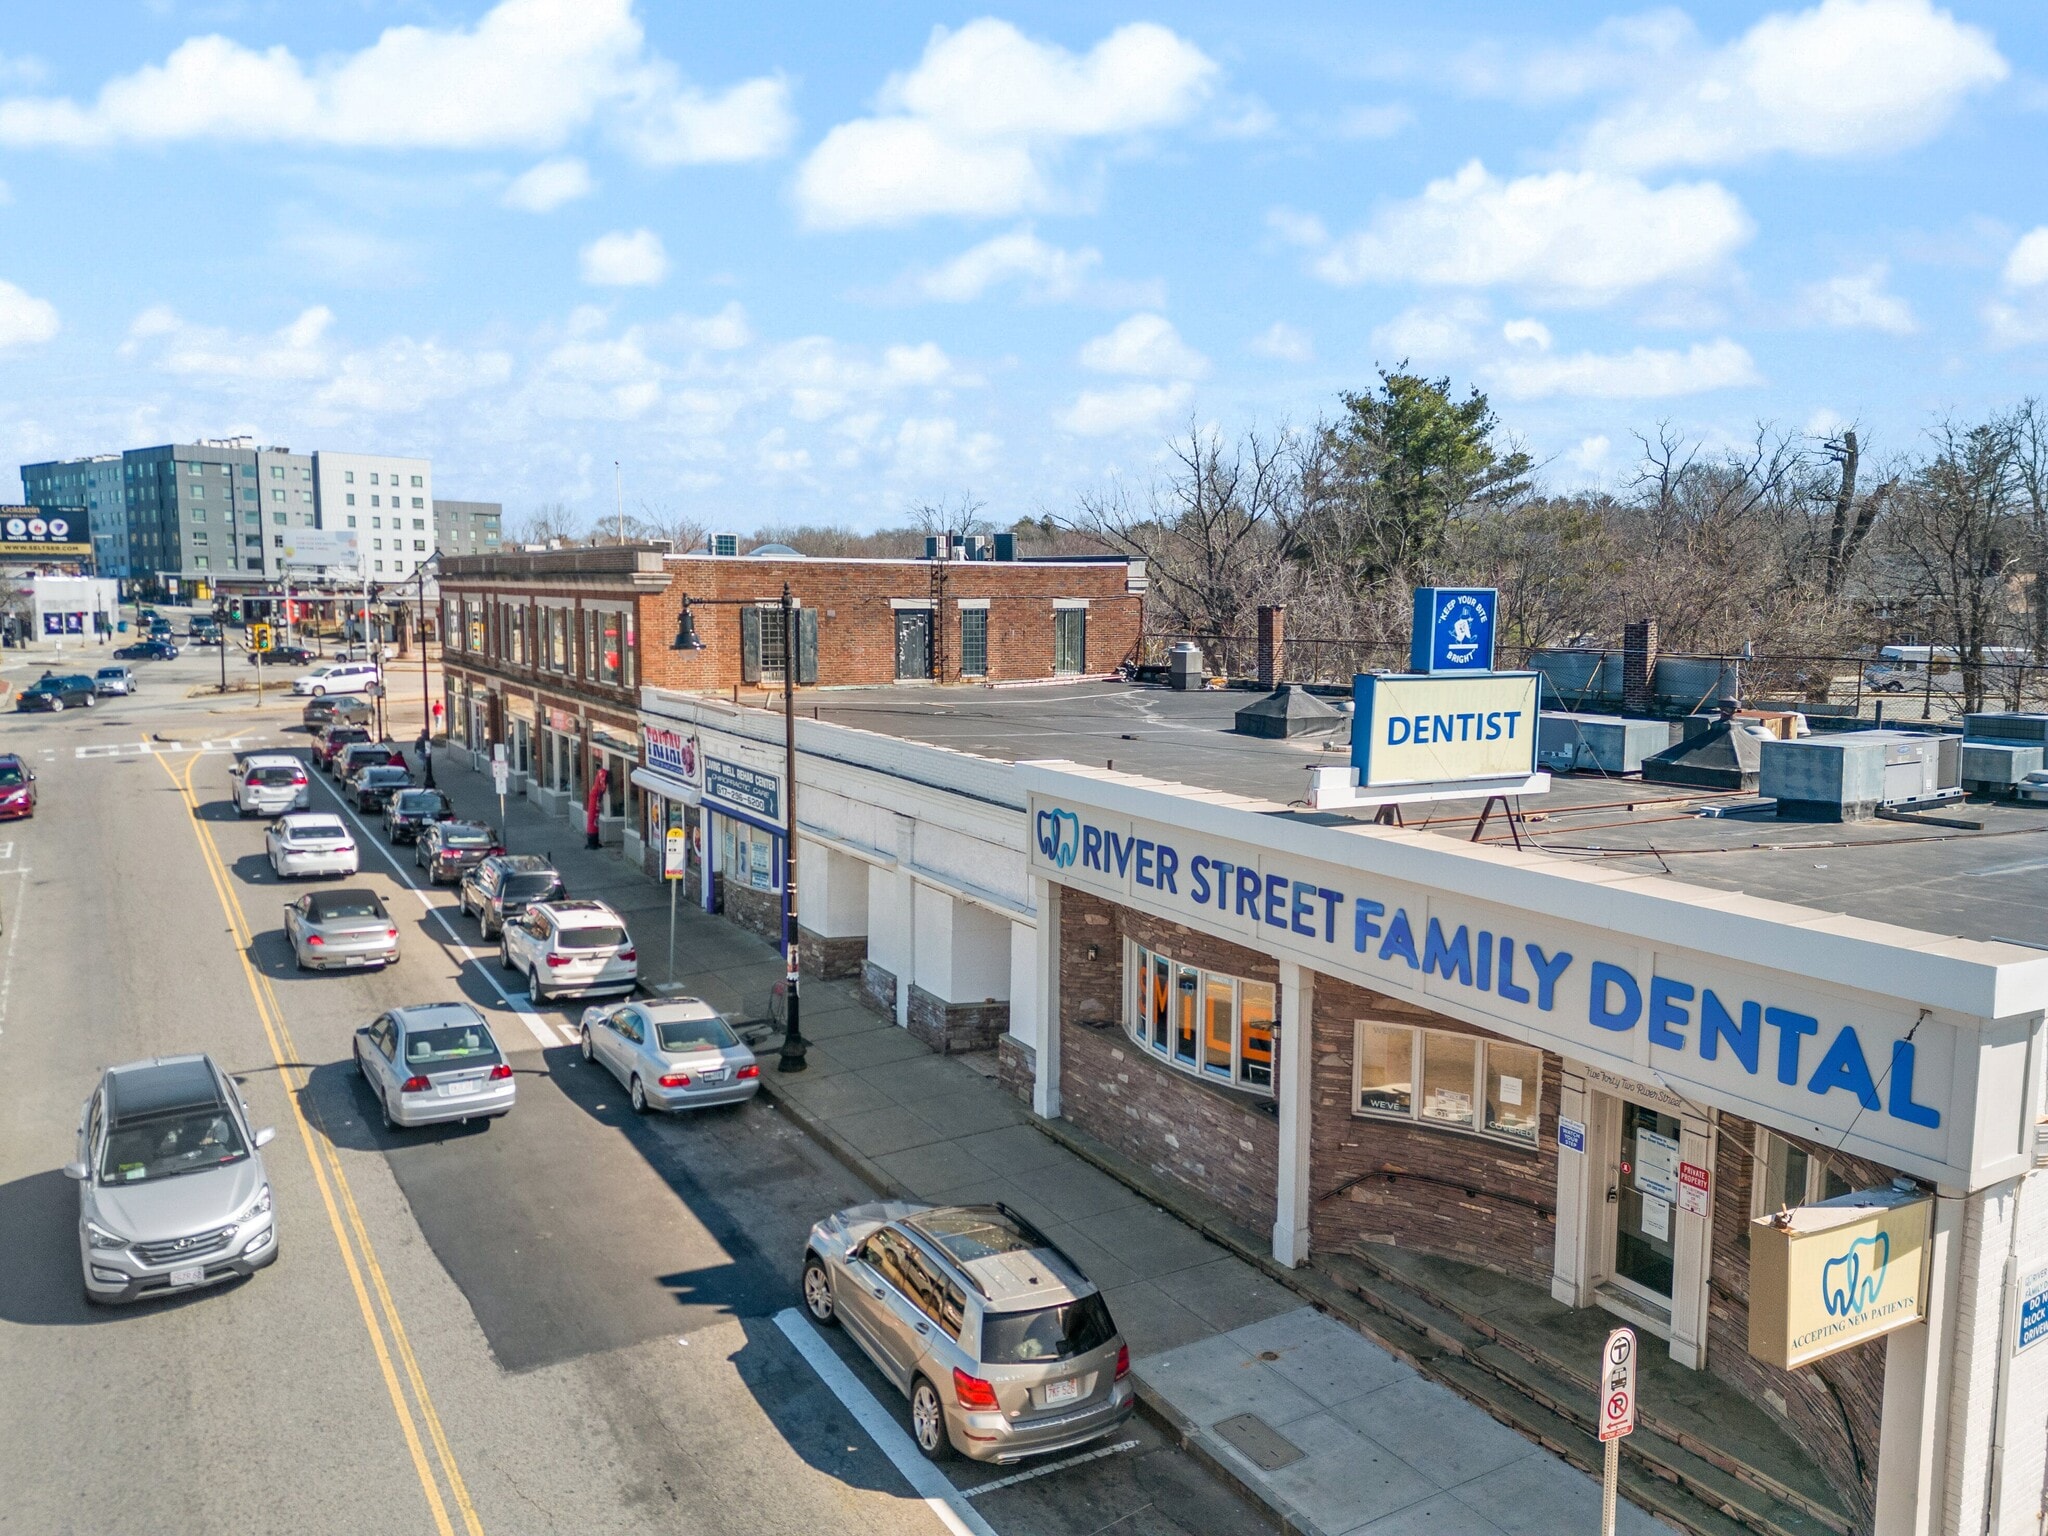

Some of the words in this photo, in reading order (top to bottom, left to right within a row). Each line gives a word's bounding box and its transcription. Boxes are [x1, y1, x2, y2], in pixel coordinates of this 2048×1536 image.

[1457, 595, 1477, 607] YOUR
[1475, 603, 1488, 623] BITE
[1387, 711, 1522, 746] DENTIST
[706, 759, 721, 773] LIVING
[721, 764, 736, 778] WELL
[736, 769, 754, 784] REHAB
[754, 775, 776, 792] CENTER
[752, 787, 770, 799] CARE
[1082, 824, 1178, 894] RIVER
[1190, 854, 1344, 943] STREET
[1354, 898, 1573, 1012] FAMILY
[1589, 961, 1940, 1129] DENTAL
[1139, 966, 1272, 1063] SMILE
[1585, 1066, 1600, 1080] Five
[1600, 1071, 1621, 1089] Forty
[1621, 1078, 1635, 1092] Two
[1636, 1083, 1658, 1099] River
[1657, 1091, 1682, 1107] Street
[1370, 1099, 1400, 1111] WE'VE
[1488, 1120, 1533, 1138] COVERED
[1564, 1133, 1579, 1144] YOUR
[1564, 1139, 1578, 1148] STEP
[1680, 1172, 1708, 1189] PROPERTY
[1683, 1165, 1706, 1180] PRIVATE
[2029, 1297, 2041, 1311] DO
[1791, 1319, 1846, 1350] ACCEPTING
[1848, 1312, 1869, 1328] NEW
[1871, 1296, 1915, 1321] PATIENTS
[2023, 1307, 2046, 1329] BLOCK
